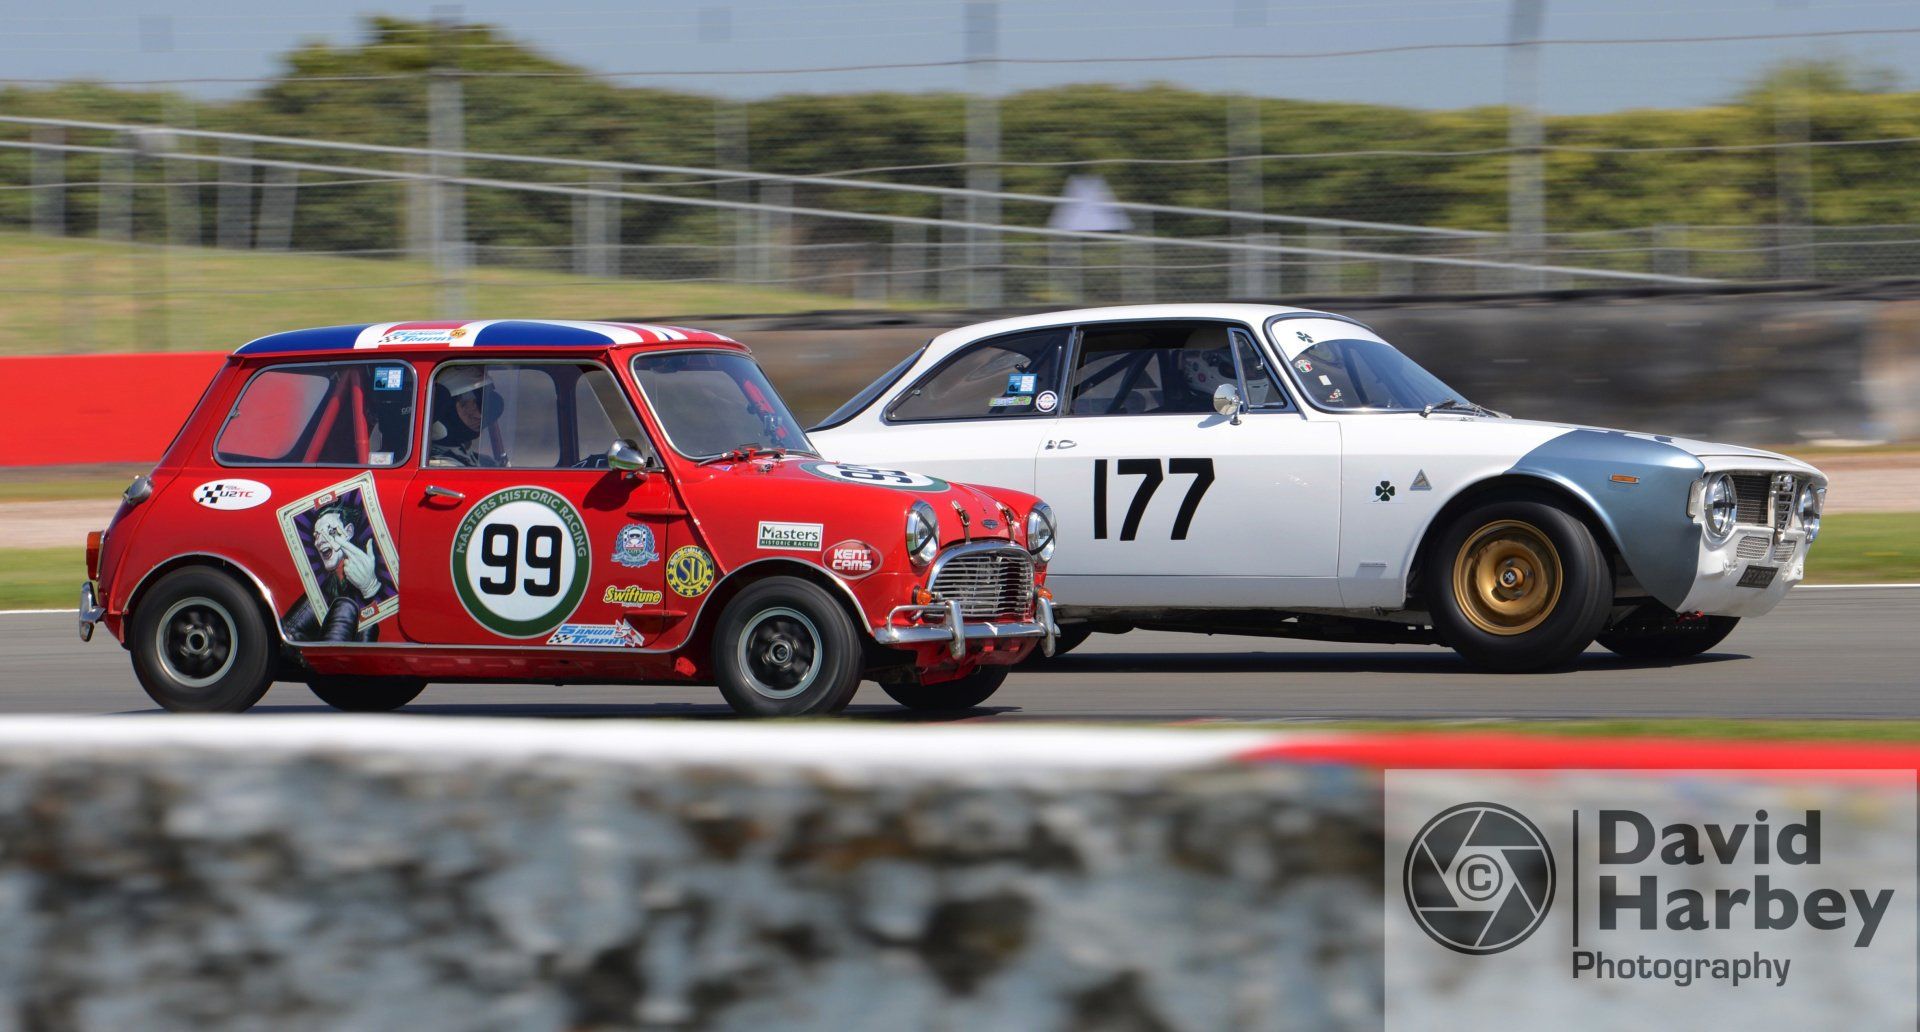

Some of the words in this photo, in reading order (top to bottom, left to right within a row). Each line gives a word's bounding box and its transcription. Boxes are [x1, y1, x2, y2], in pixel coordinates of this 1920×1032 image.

[1094, 457, 1215, 541] 177
[456, 498, 497, 554] MASTERS
[499, 490, 560, 509] HISTORIC
[559, 506, 587, 557] RACING
[761, 526, 818, 541] Masters
[479, 523, 563, 598] 99
[833, 549, 871, 560] KENT
[832, 559, 872, 571] CAMS
[605, 586, 661, 603] Swiftune
[571, 635, 629, 645] TROPHY
